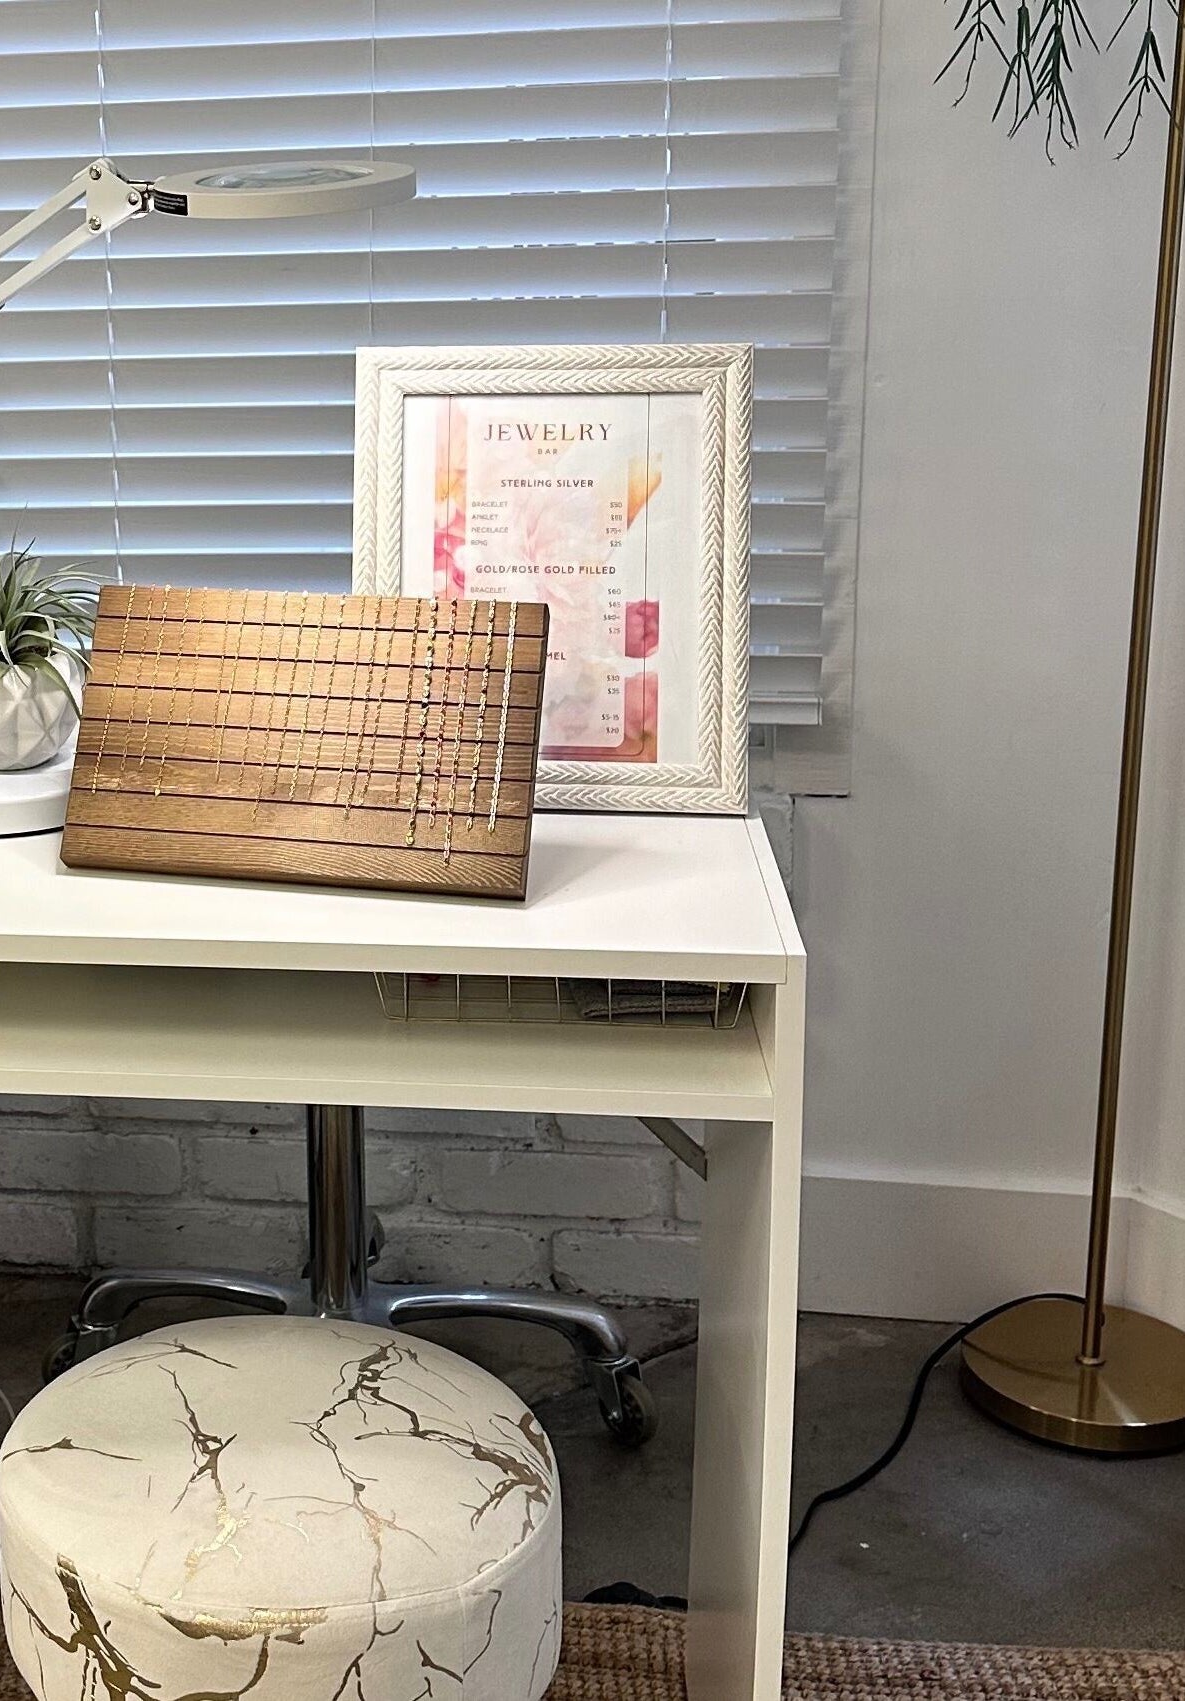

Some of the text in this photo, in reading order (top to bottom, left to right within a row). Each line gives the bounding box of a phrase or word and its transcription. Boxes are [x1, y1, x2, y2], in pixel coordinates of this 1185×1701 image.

[483, 423, 612, 441] JEWELRY
[500, 479, 594, 488] STERLING SILVER
[475, 565, 616, 575] GOLD/ROSE GOLD FILLED
[470, 586, 507, 594] BRACELET
[546, 651, 566, 661] MEL
